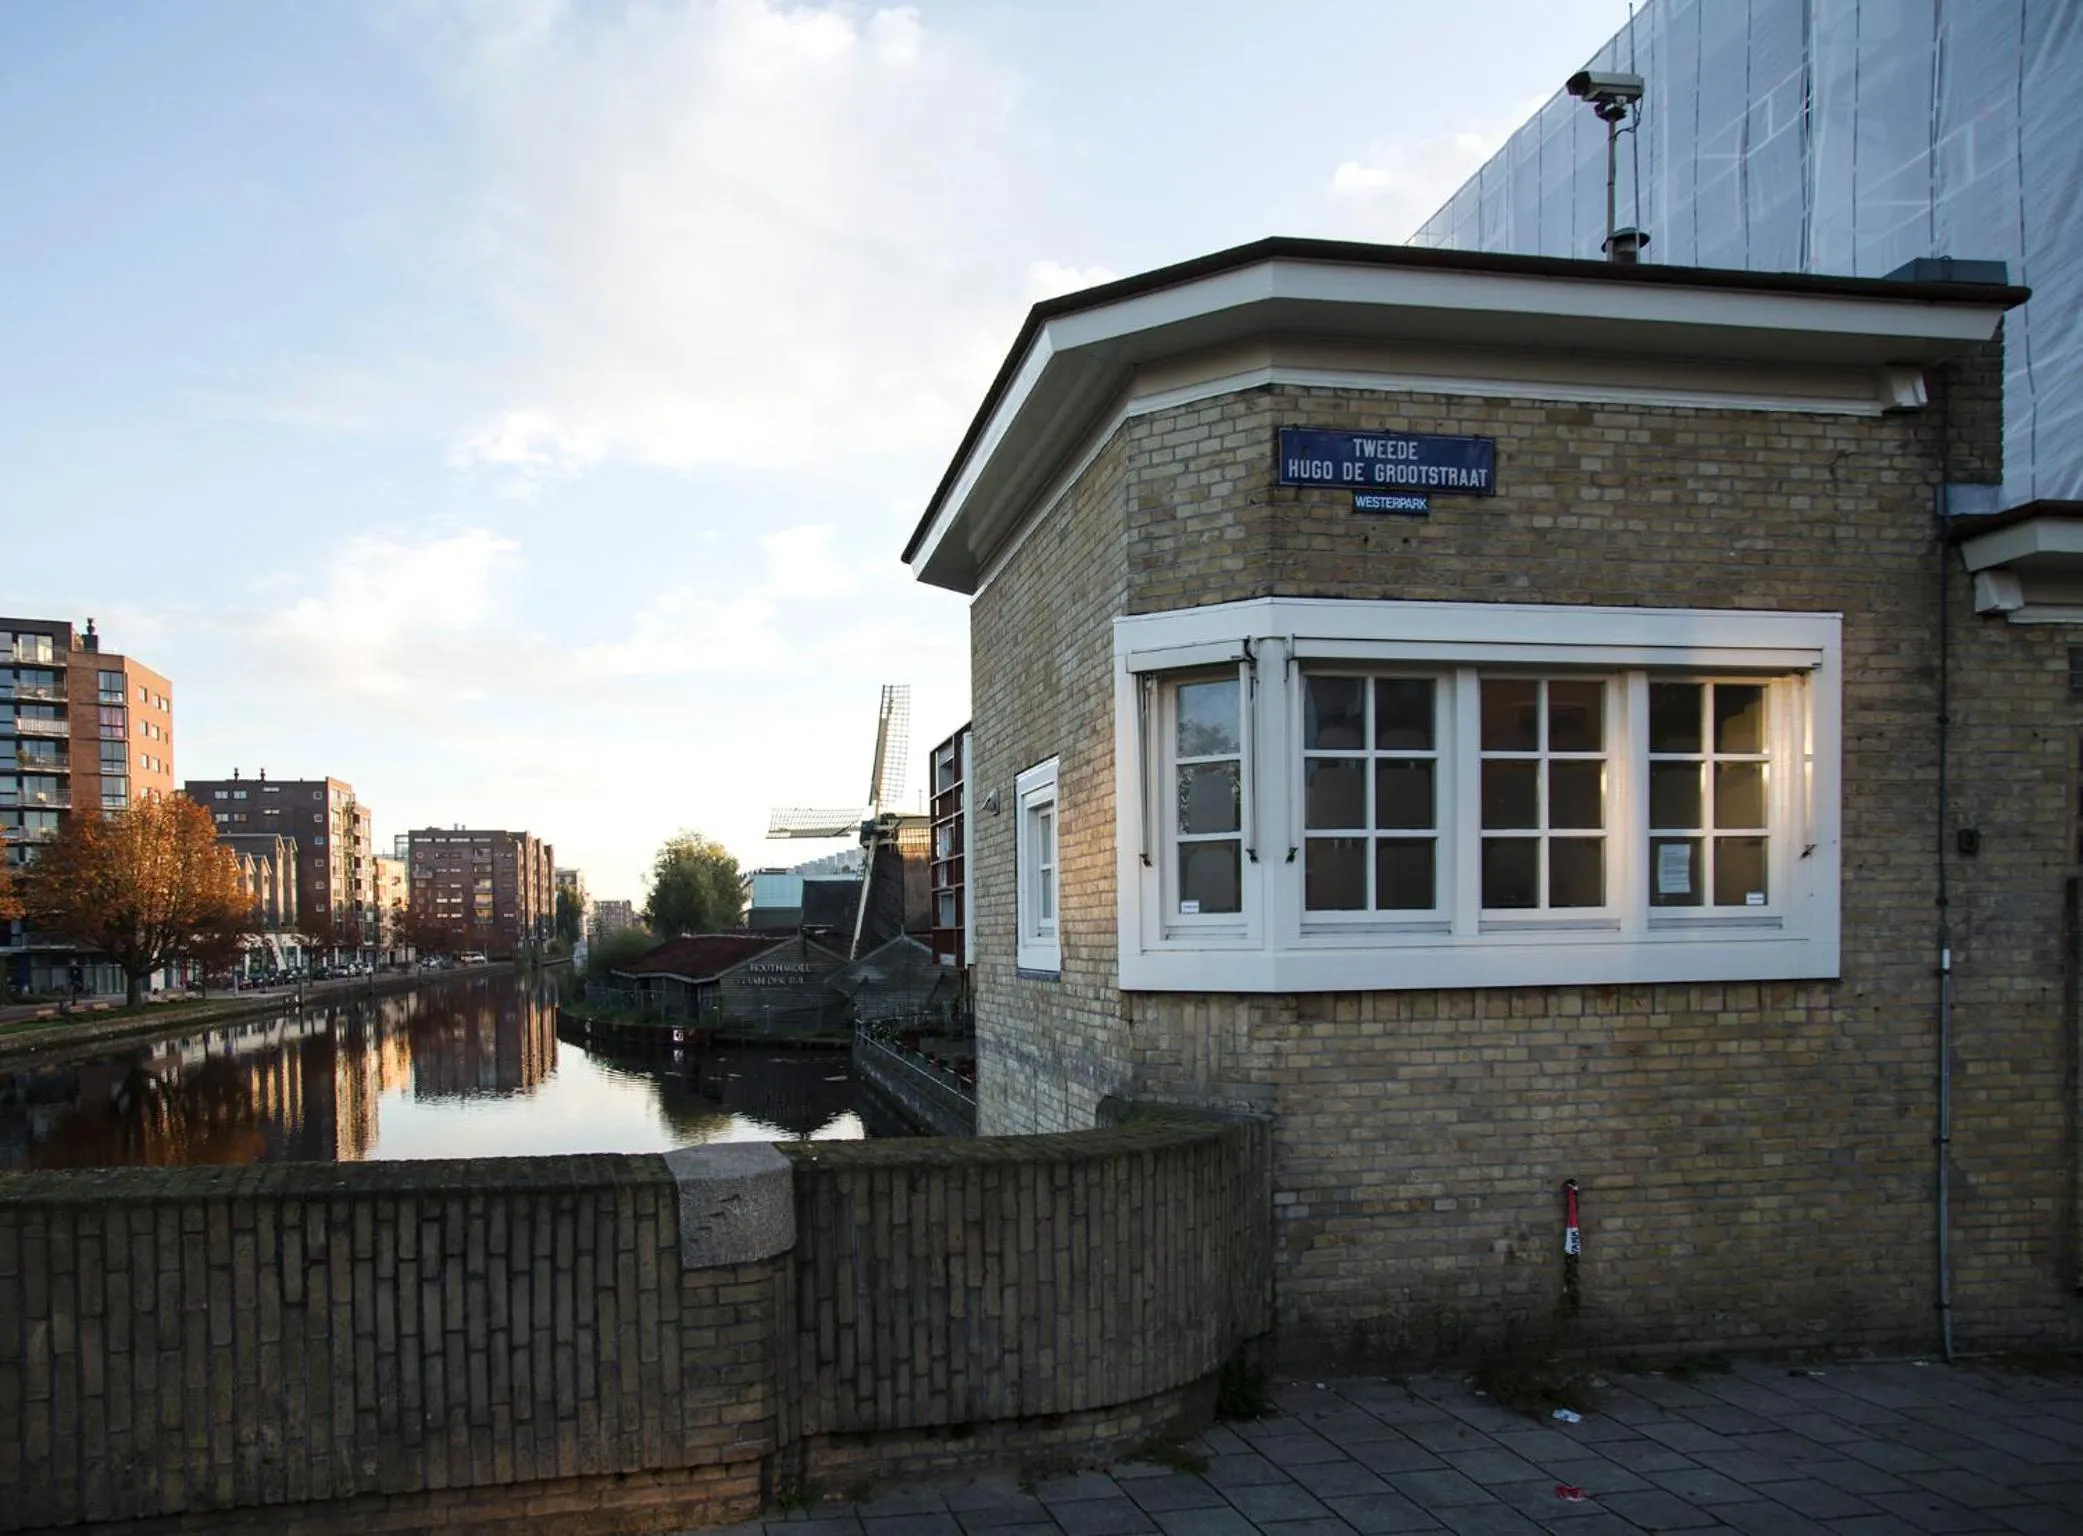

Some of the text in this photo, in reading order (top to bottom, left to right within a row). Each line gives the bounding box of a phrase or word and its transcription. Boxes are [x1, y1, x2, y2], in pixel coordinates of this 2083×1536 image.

[1353, 438, 1418, 460] TWEEDE
[1288, 459, 1489, 488] HUGO DE GROOTSTRAAT
[1355, 495, 1428, 510] WESTERPARK
